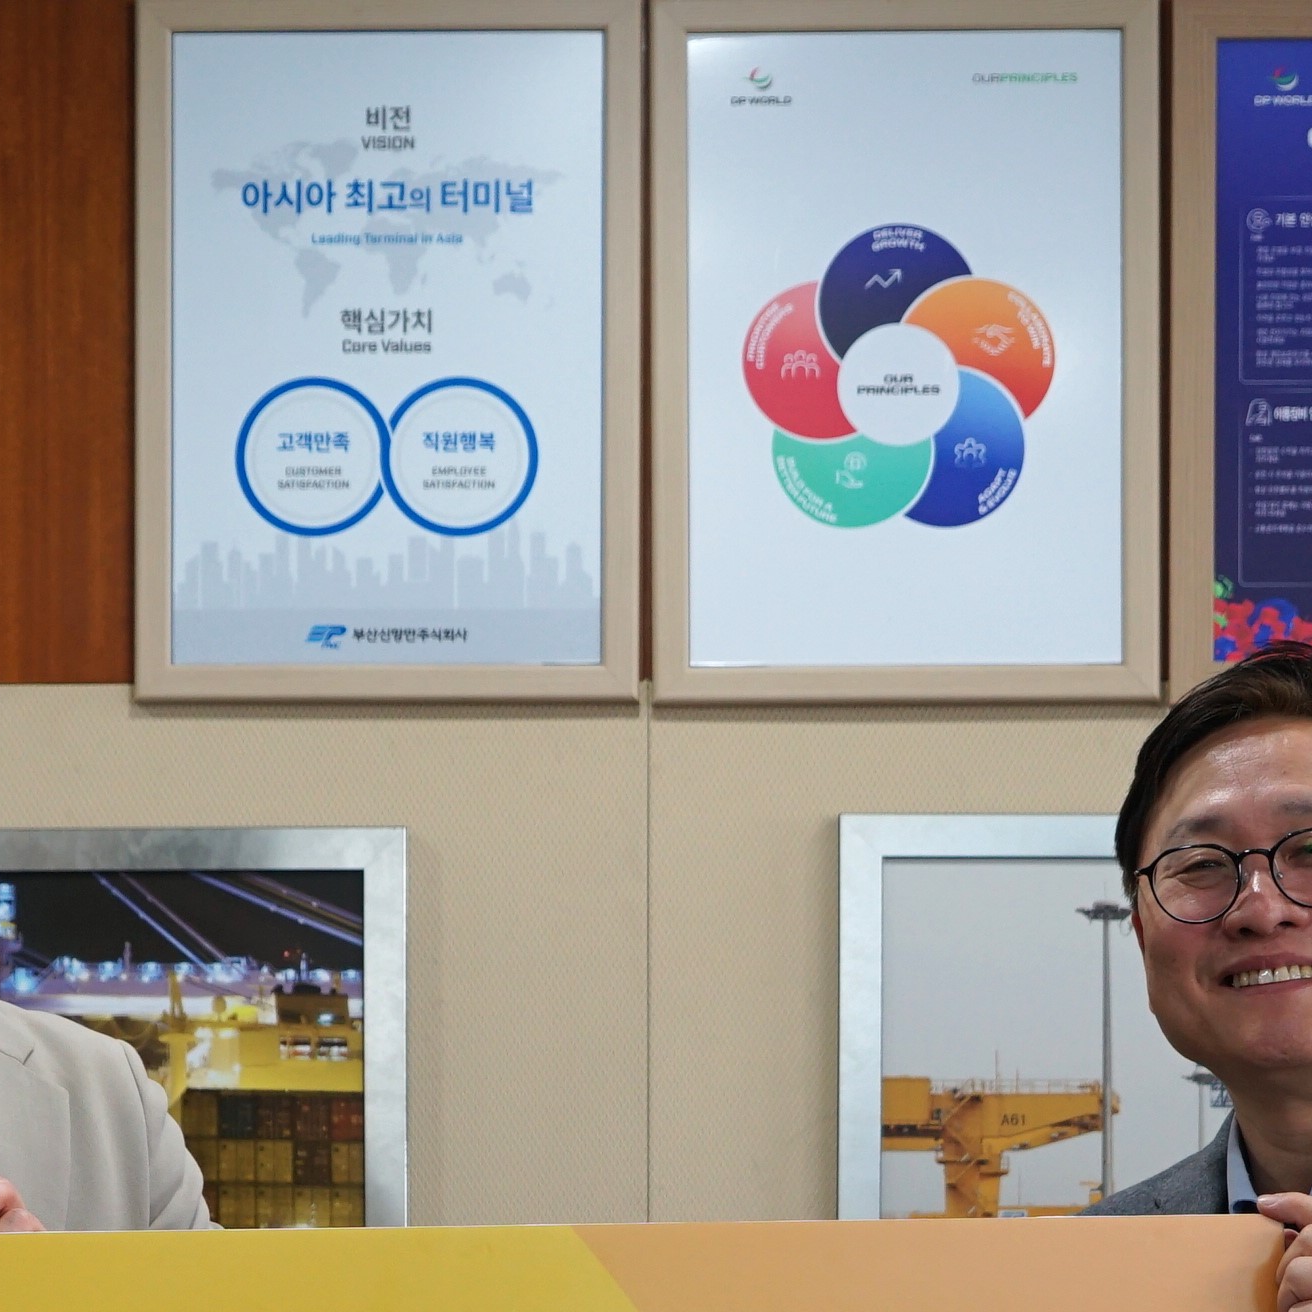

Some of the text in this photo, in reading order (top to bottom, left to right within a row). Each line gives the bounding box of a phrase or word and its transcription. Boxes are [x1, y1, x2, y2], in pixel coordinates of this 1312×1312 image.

[749, 95, 792, 107] WORLD
[365, 105, 412, 131] 비전
[361, 136, 415, 151] VISION
[241, 179, 534, 215] 아시아 최고의 터미널
[1275, 211, 1297, 228] 기본
[311, 232, 463, 245] Leading Terminal in Asia
[340, 307, 433, 335] 핵심가치
[341, 338, 432, 354] Core Values
[883, 374, 914, 383] OUR
[856, 384, 941, 396] PRINCIPLES
[276, 431, 351, 453] 고객만족
[423, 431, 496, 453] 직원행복
[285, 466, 341, 477] CUSTOMER
[432, 466, 487, 477] EMPLOYEE
[277, 479, 350, 490] SATISFACTION
[422, 479, 496, 490] SATISFACTION
[352, 627, 468, 644] 부산신항만주식회사
[1001, 1113, 1026, 1126] A61
